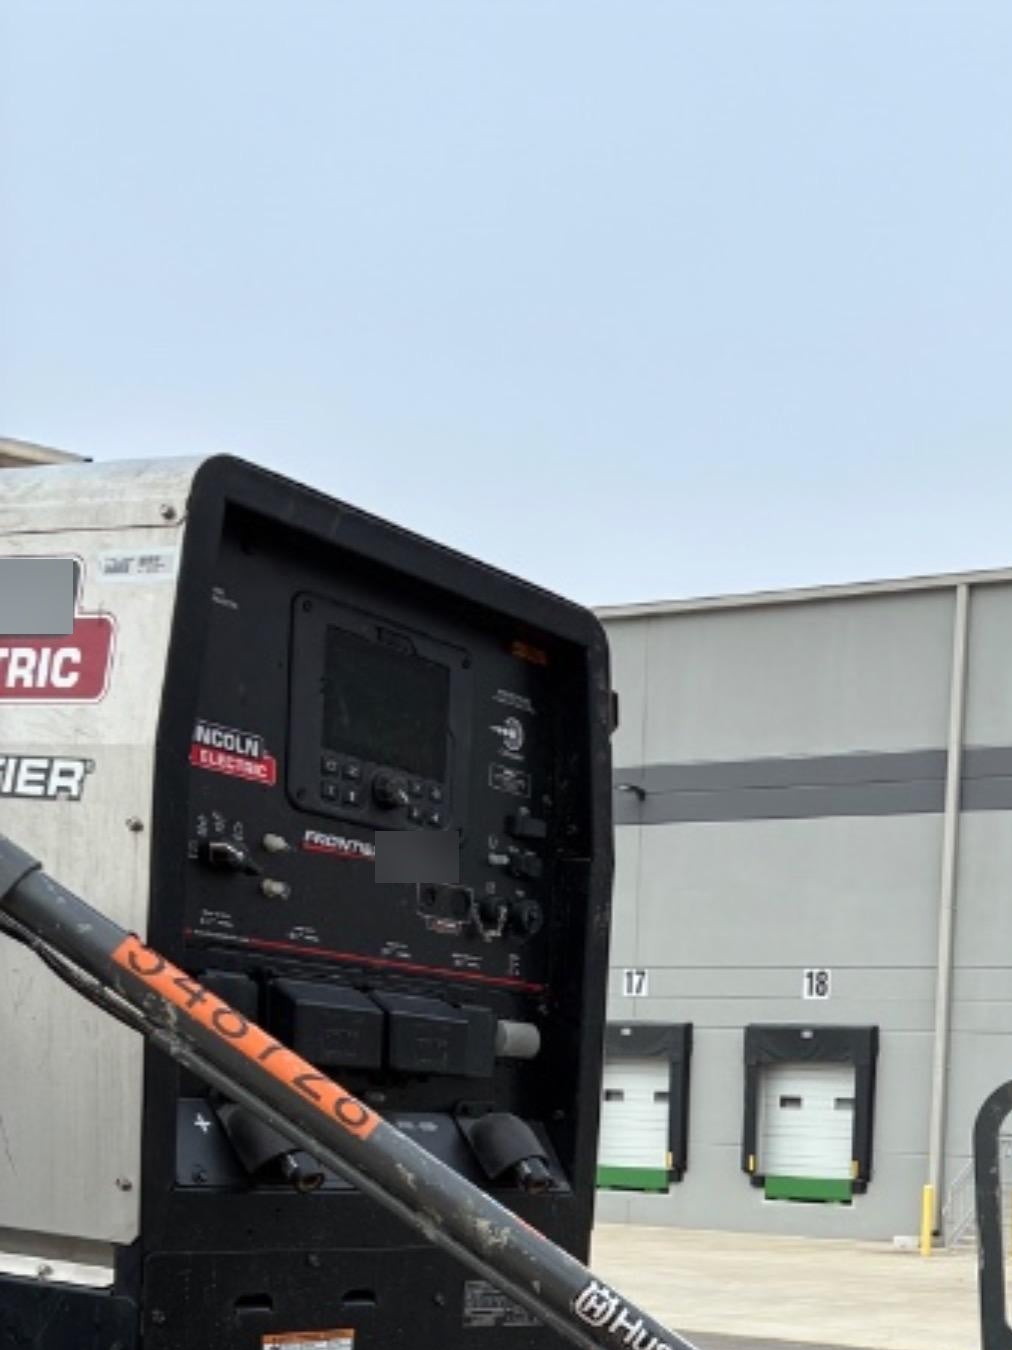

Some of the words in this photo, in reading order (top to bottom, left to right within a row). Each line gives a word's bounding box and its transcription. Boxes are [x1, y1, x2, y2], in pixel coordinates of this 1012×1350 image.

[0, 757, 85, 796] IER
[625, 970, 646, 995] 17
[805, 970, 829, 997] 18
